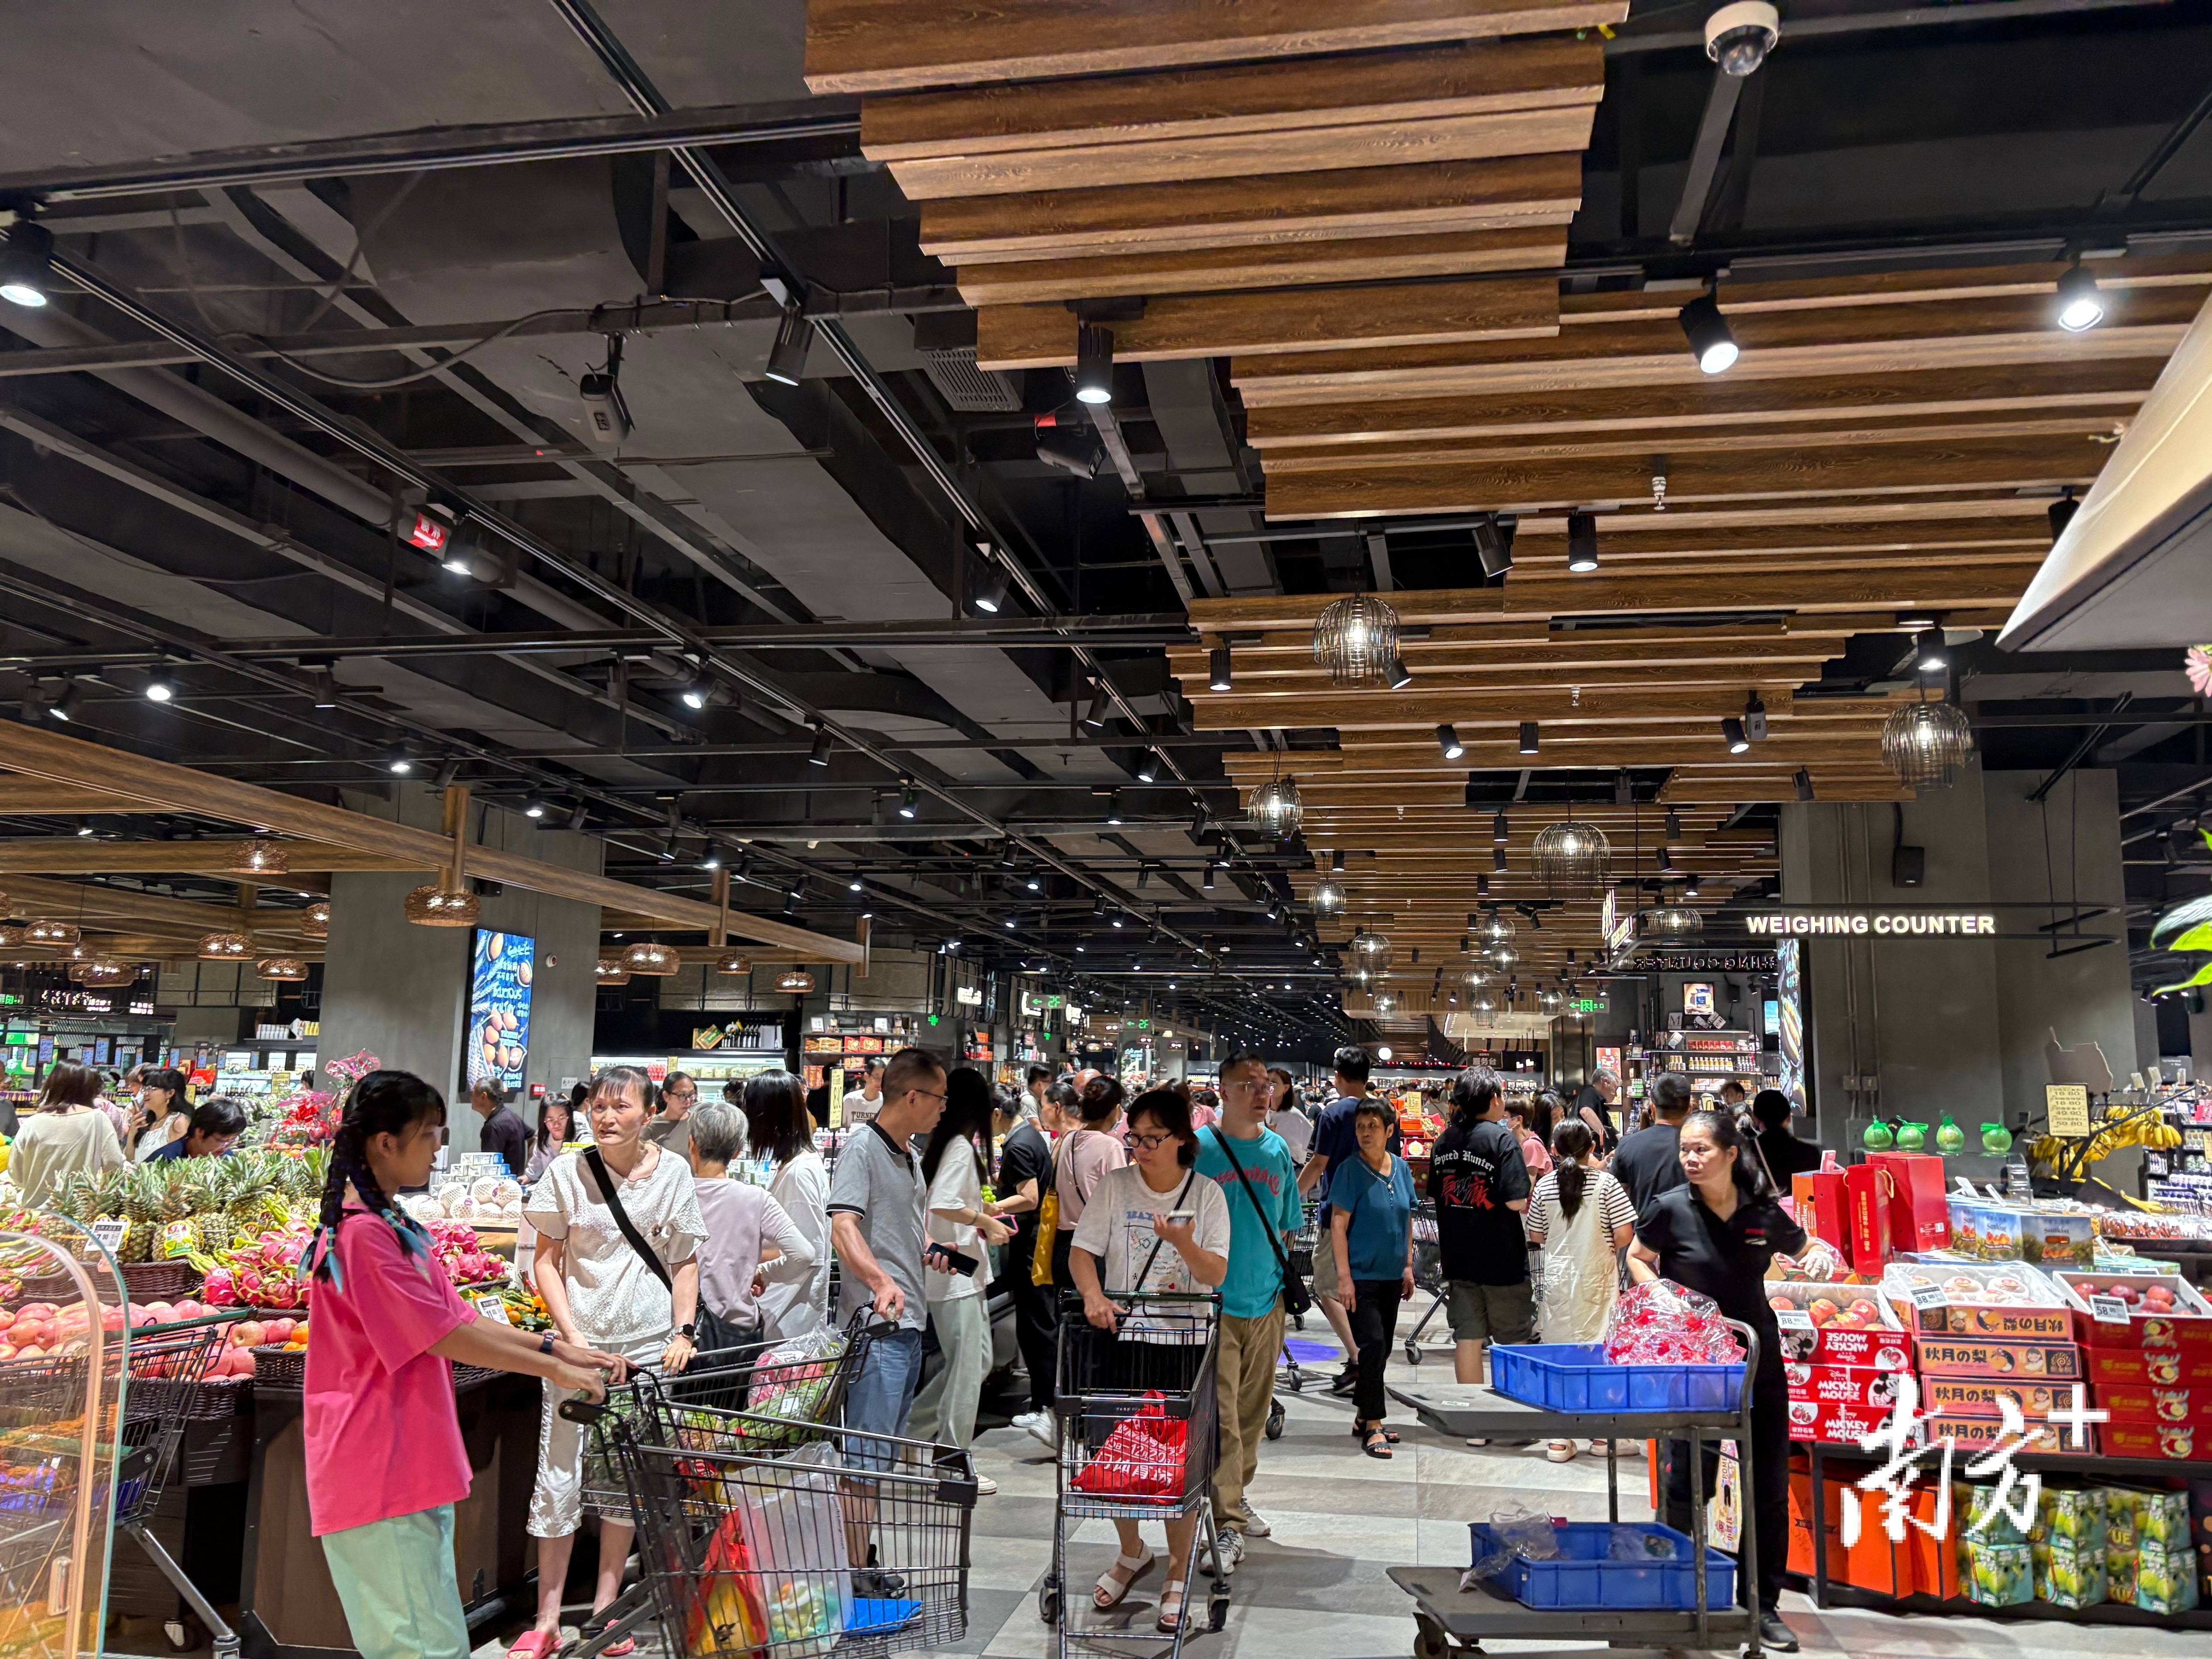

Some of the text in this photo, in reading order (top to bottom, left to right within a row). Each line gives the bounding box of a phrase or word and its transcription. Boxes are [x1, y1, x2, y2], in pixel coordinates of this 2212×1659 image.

[1746, 916, 1996, 934] WEIGHING COUNTER
[1048, 996, 1060, 1008] 2F
[1434, 1150, 1494, 1172] Speed Hunter
[1826, 1332, 1866, 1342] MOUSE
[1825, 1341, 1868, 1352] MICKEY
[1925, 1347, 1987, 1363] 秋月の梨
[1817, 1380, 1862, 1391] MICKEY
[1819, 1390, 1860, 1401] MOUSE
[1935, 1387, 1996, 1403] 秋月の梨
[1825, 1419, 1869, 1430] MICKEY
